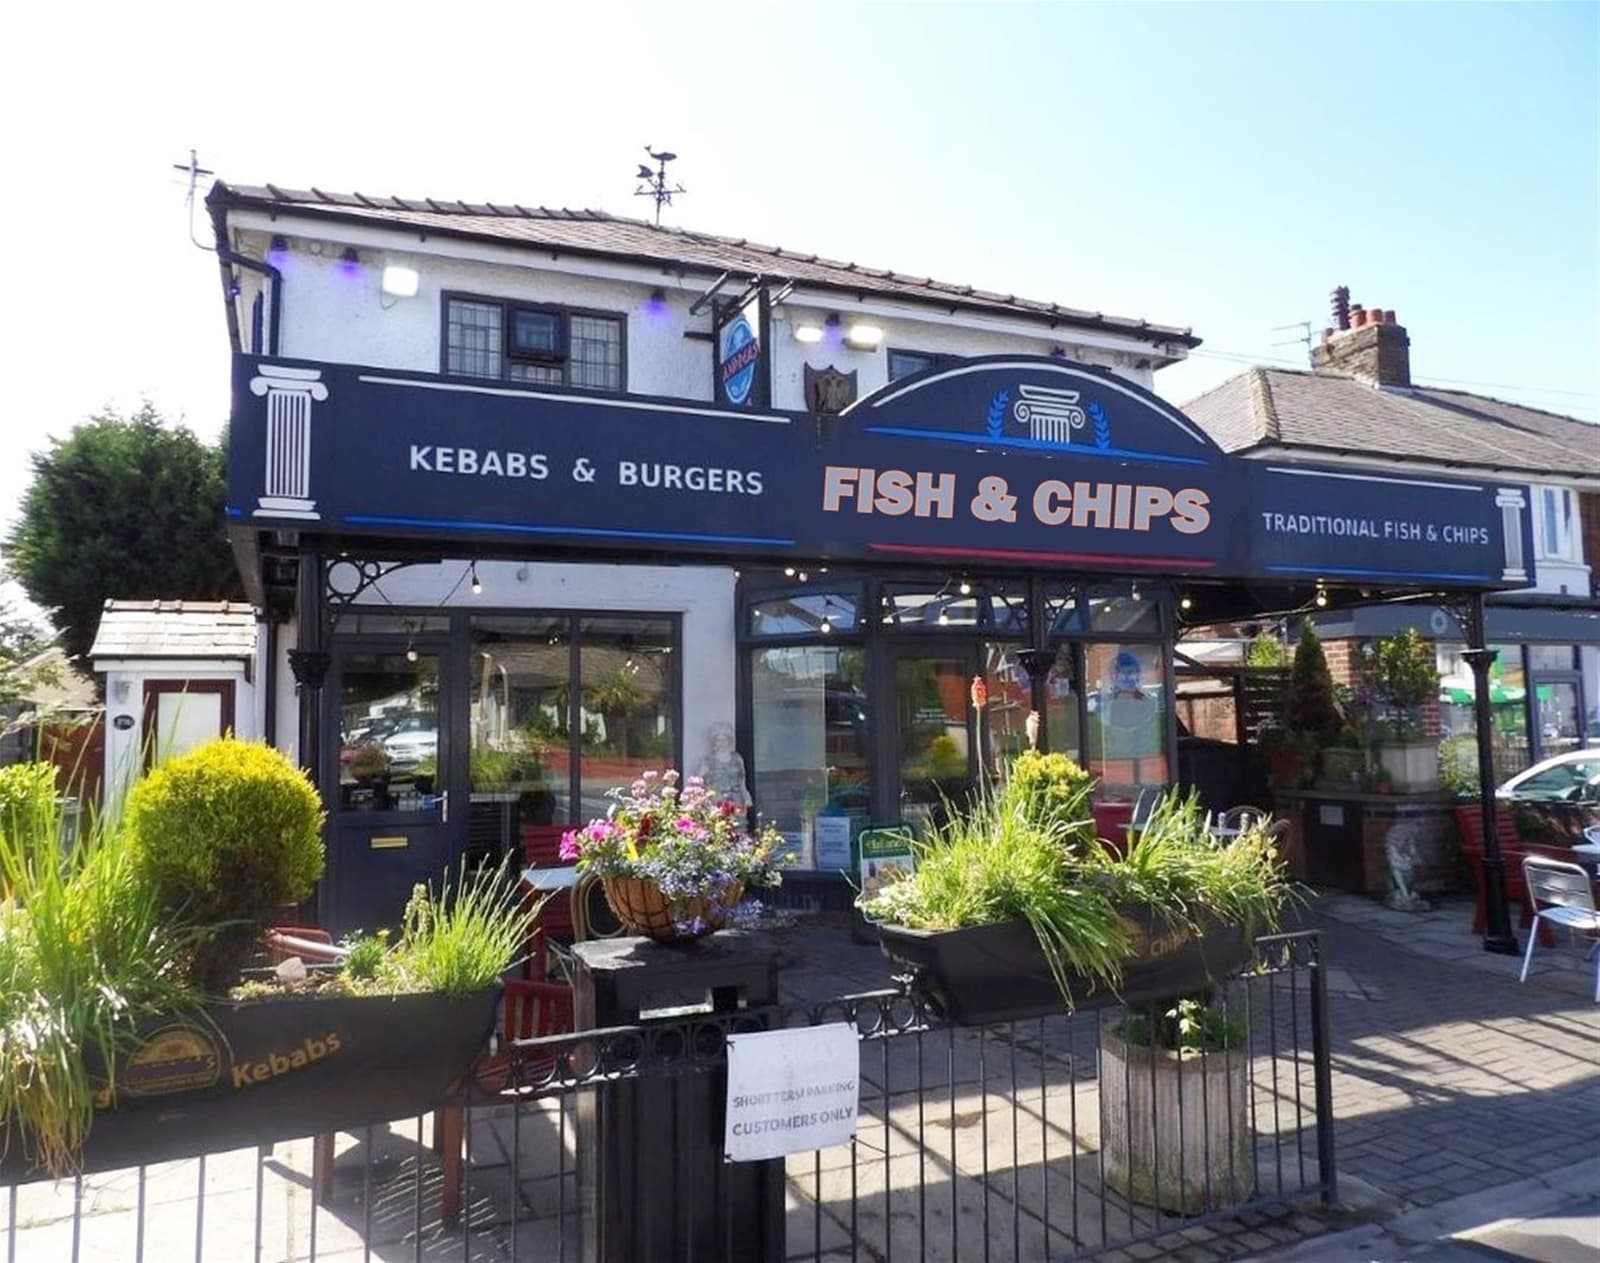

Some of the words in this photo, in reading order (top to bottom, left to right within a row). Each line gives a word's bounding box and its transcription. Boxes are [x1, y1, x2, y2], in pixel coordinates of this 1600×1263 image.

[409, 445, 549, 480] KEBABS
[572, 458, 596, 482] &
[618, 461, 764, 495] BURGERS
[823, 466, 956, 518] FISH
[970, 476, 1017, 523] &
[1032, 480, 1211, 534] CHIPS
[1262, 512, 1380, 538] TRADITIONAL
[1384, 521, 1421, 540] FISH
[1426, 524, 1438, 541] &
[1442, 525, 1489, 545] CHIPS
[231, 1032, 342, 1088] Kebabs
[732, 1112, 818, 1136] CUSTOMERS
[819, 1107, 853, 1124] ONLY
